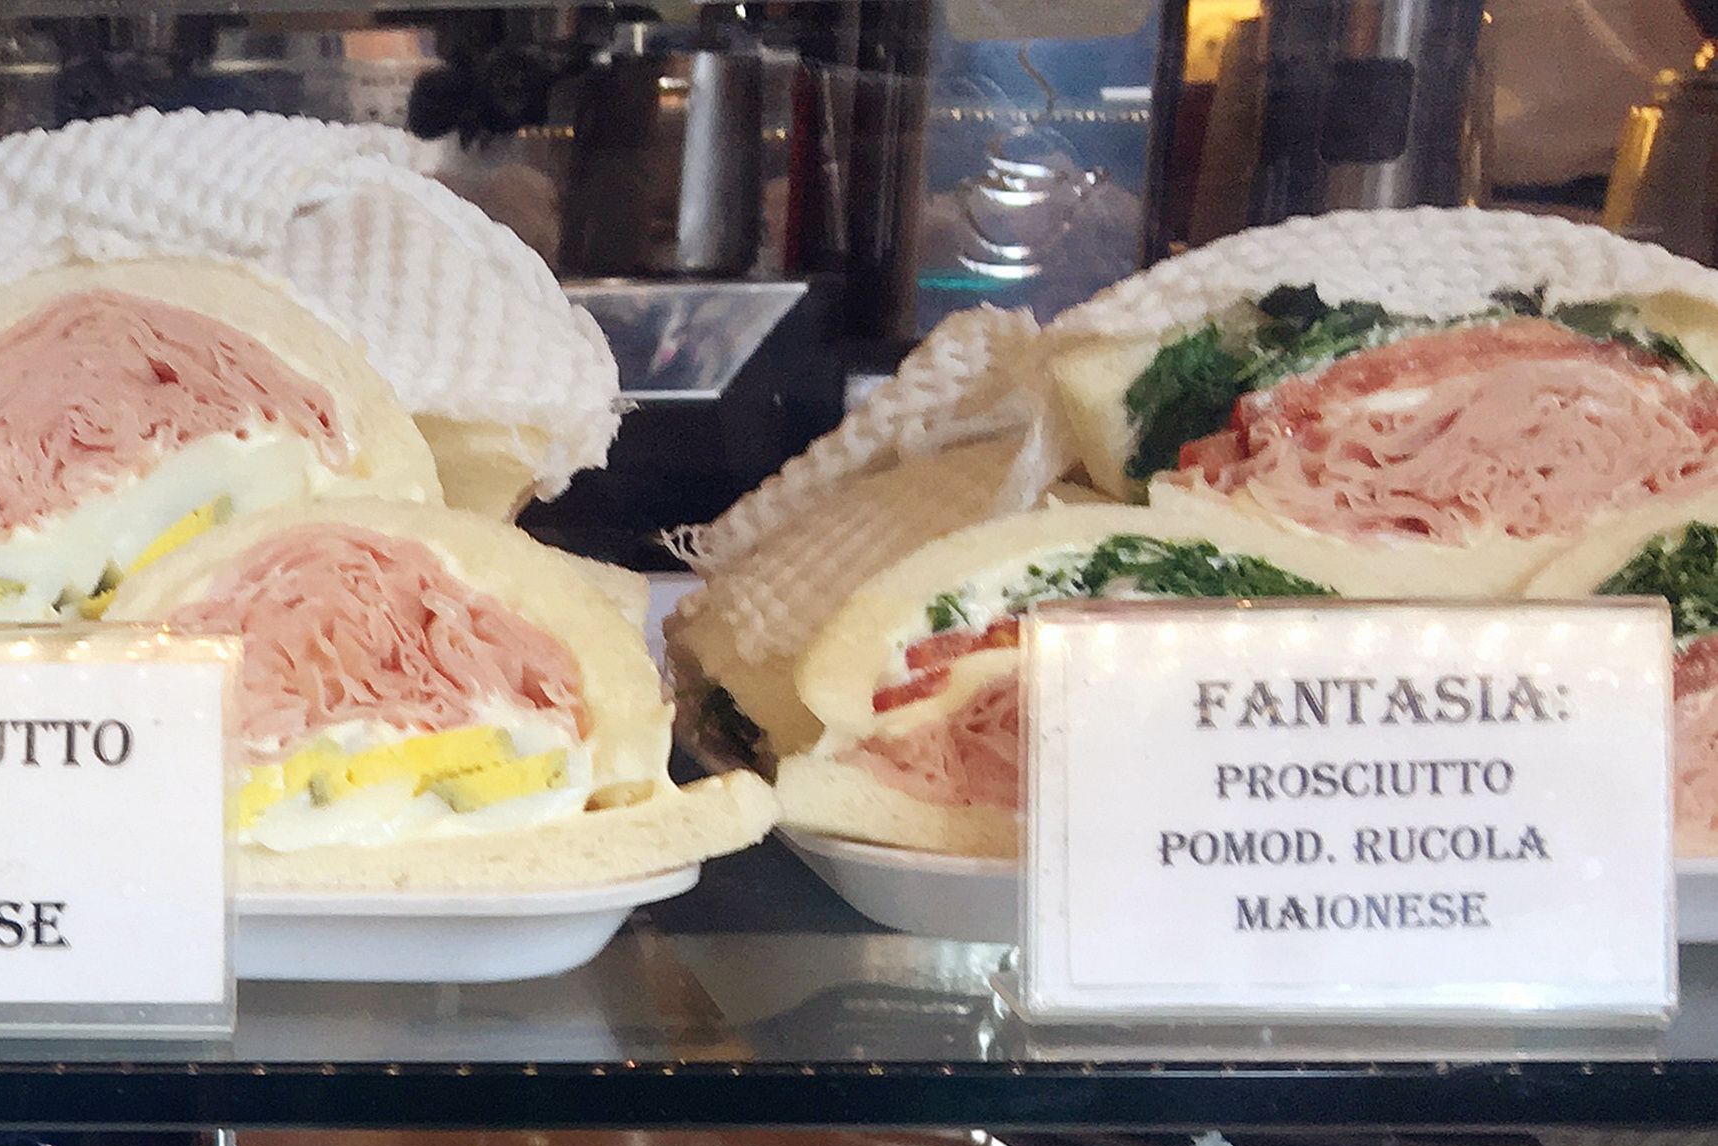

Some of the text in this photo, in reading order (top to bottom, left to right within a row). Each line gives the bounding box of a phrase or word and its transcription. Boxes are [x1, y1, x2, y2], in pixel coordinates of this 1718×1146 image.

[1194, 676, 1572, 728] FANTASIA:
[1216, 760, 1515, 801] PROSCIUTTO
[1157, 826, 1550, 866] POMOD. RUCOLA
[1235, 892, 1491, 930] MAIONESE
